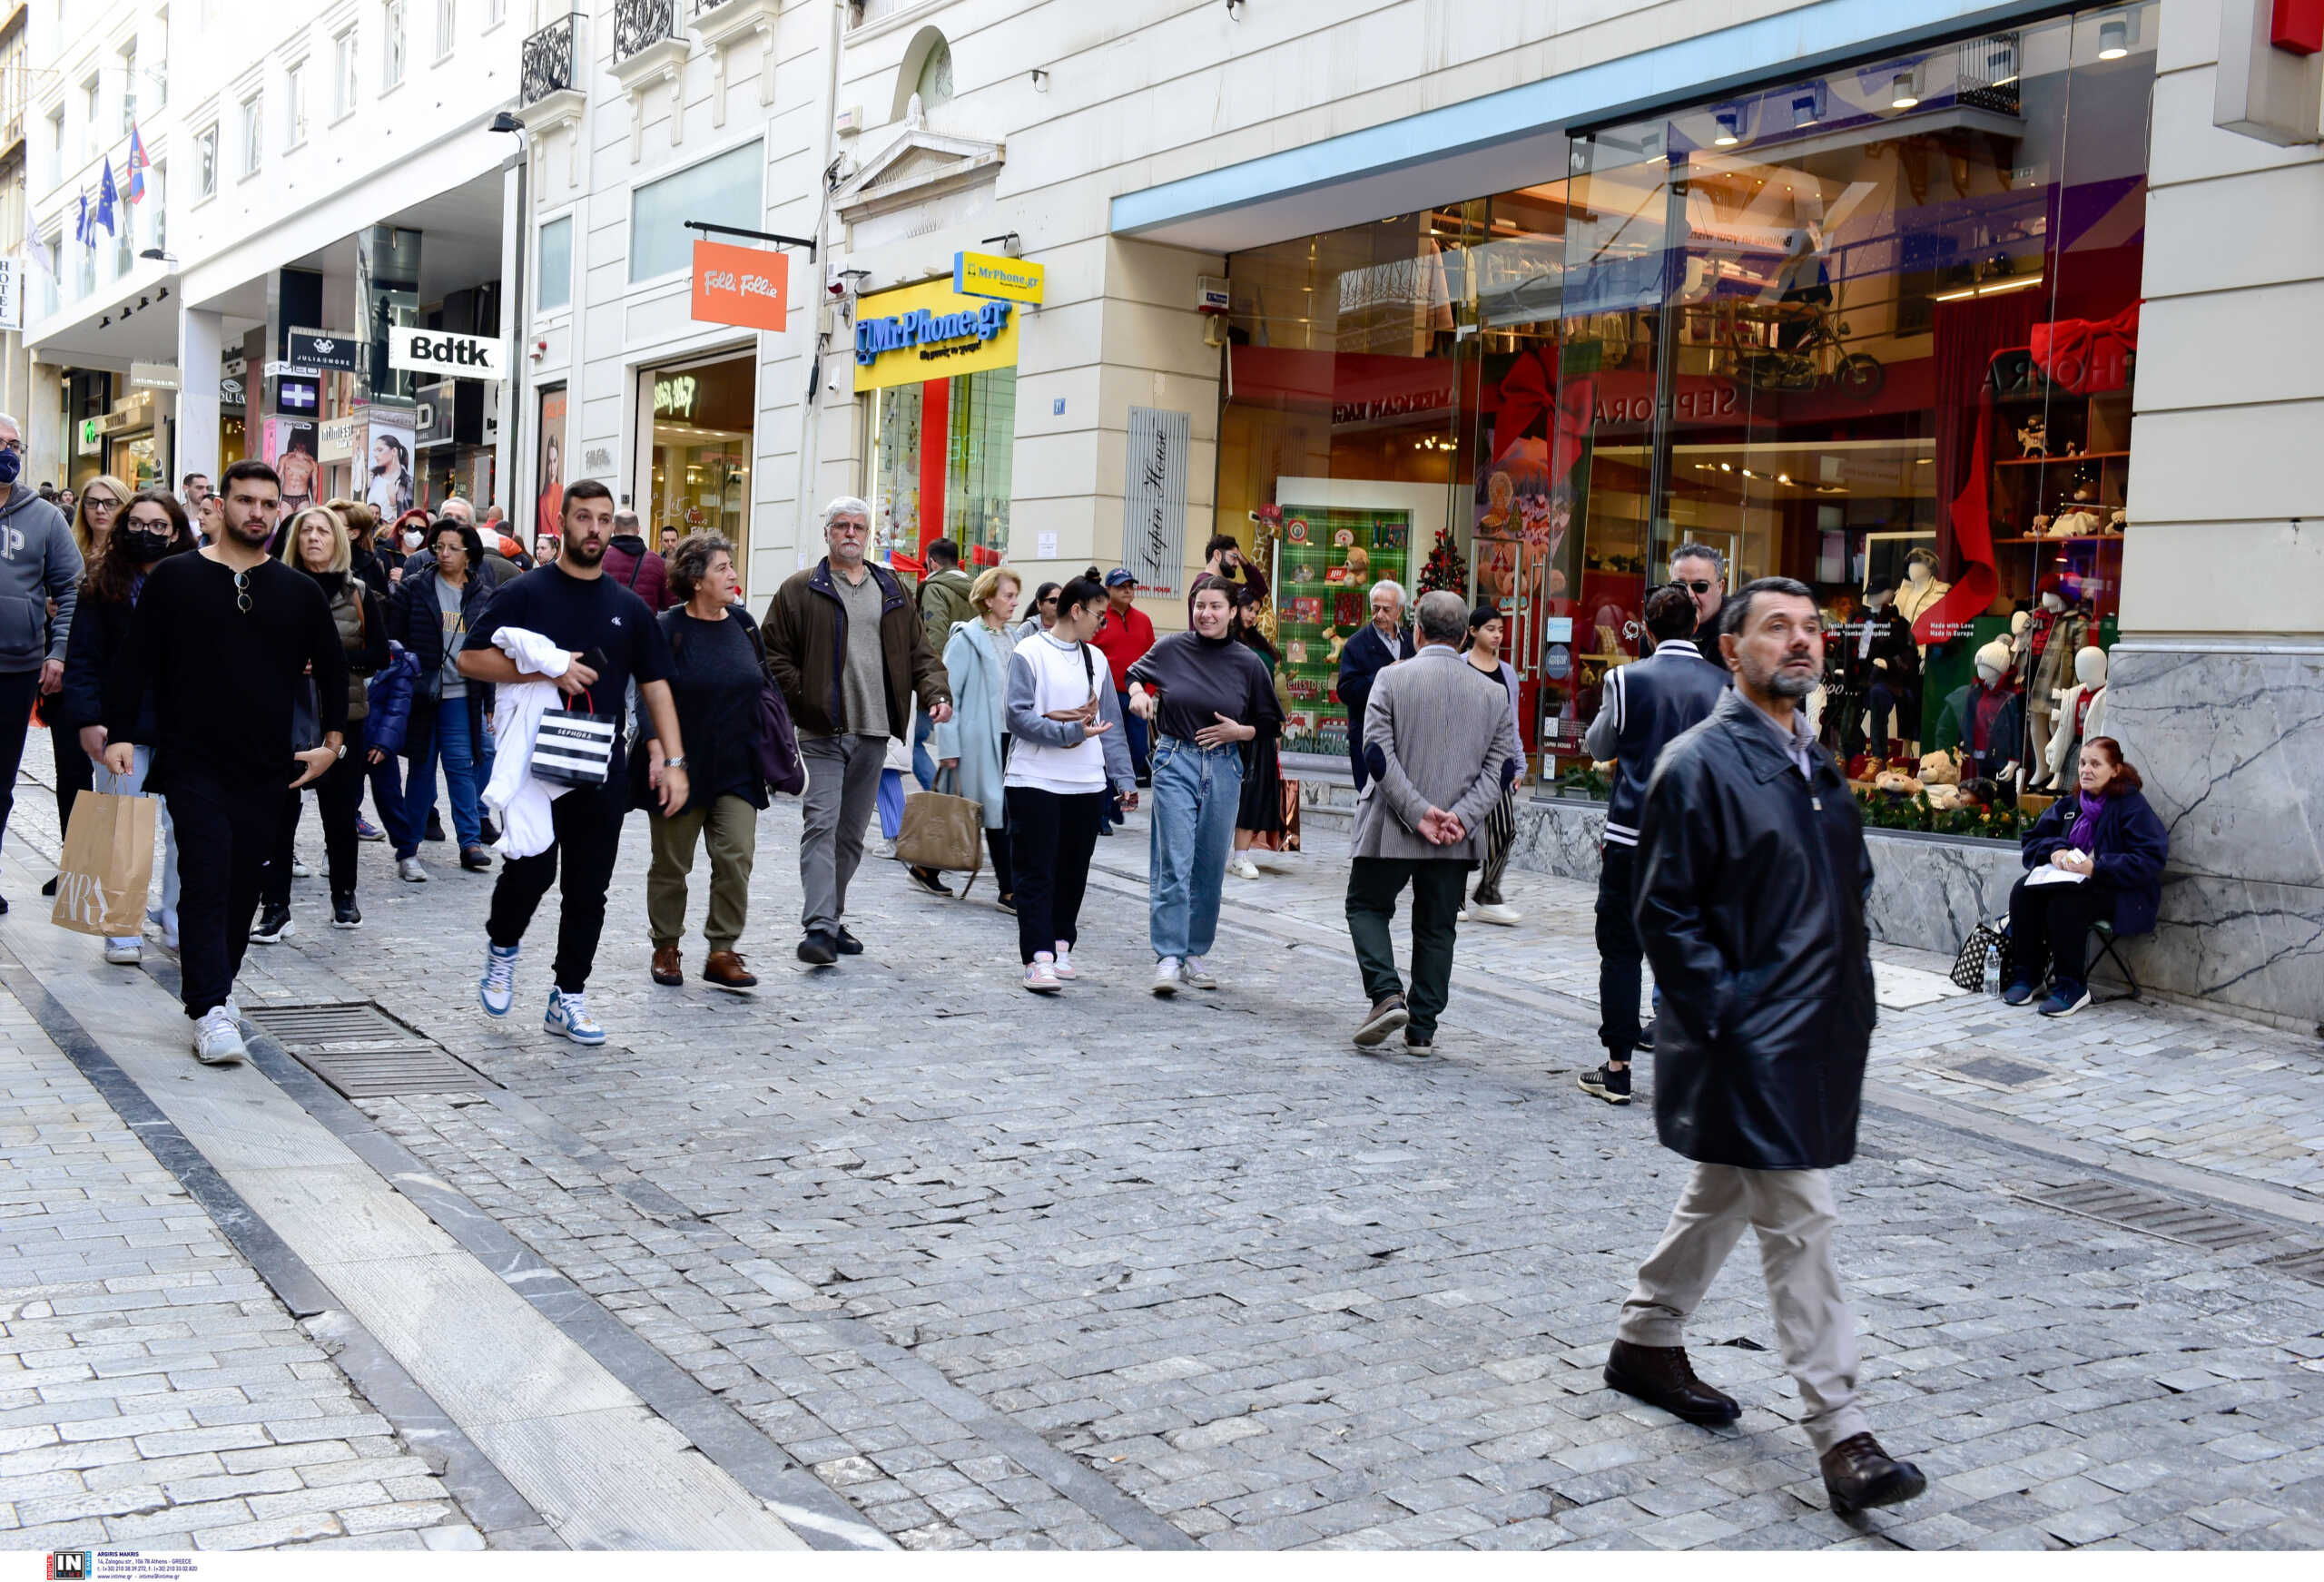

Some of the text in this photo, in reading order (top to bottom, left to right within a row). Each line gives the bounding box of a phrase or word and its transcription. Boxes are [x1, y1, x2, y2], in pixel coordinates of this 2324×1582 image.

[704, 270, 778, 298] Folli Follie
[979, 266, 1039, 289] MrPhone.gr
[872, 301, 1012, 353] MrPhone.gr
[1141, 428, 1168, 578] Lapin House
[557, 728, 592, 740] SEPHORA
[1315, 739, 1350, 755] HOUSE
